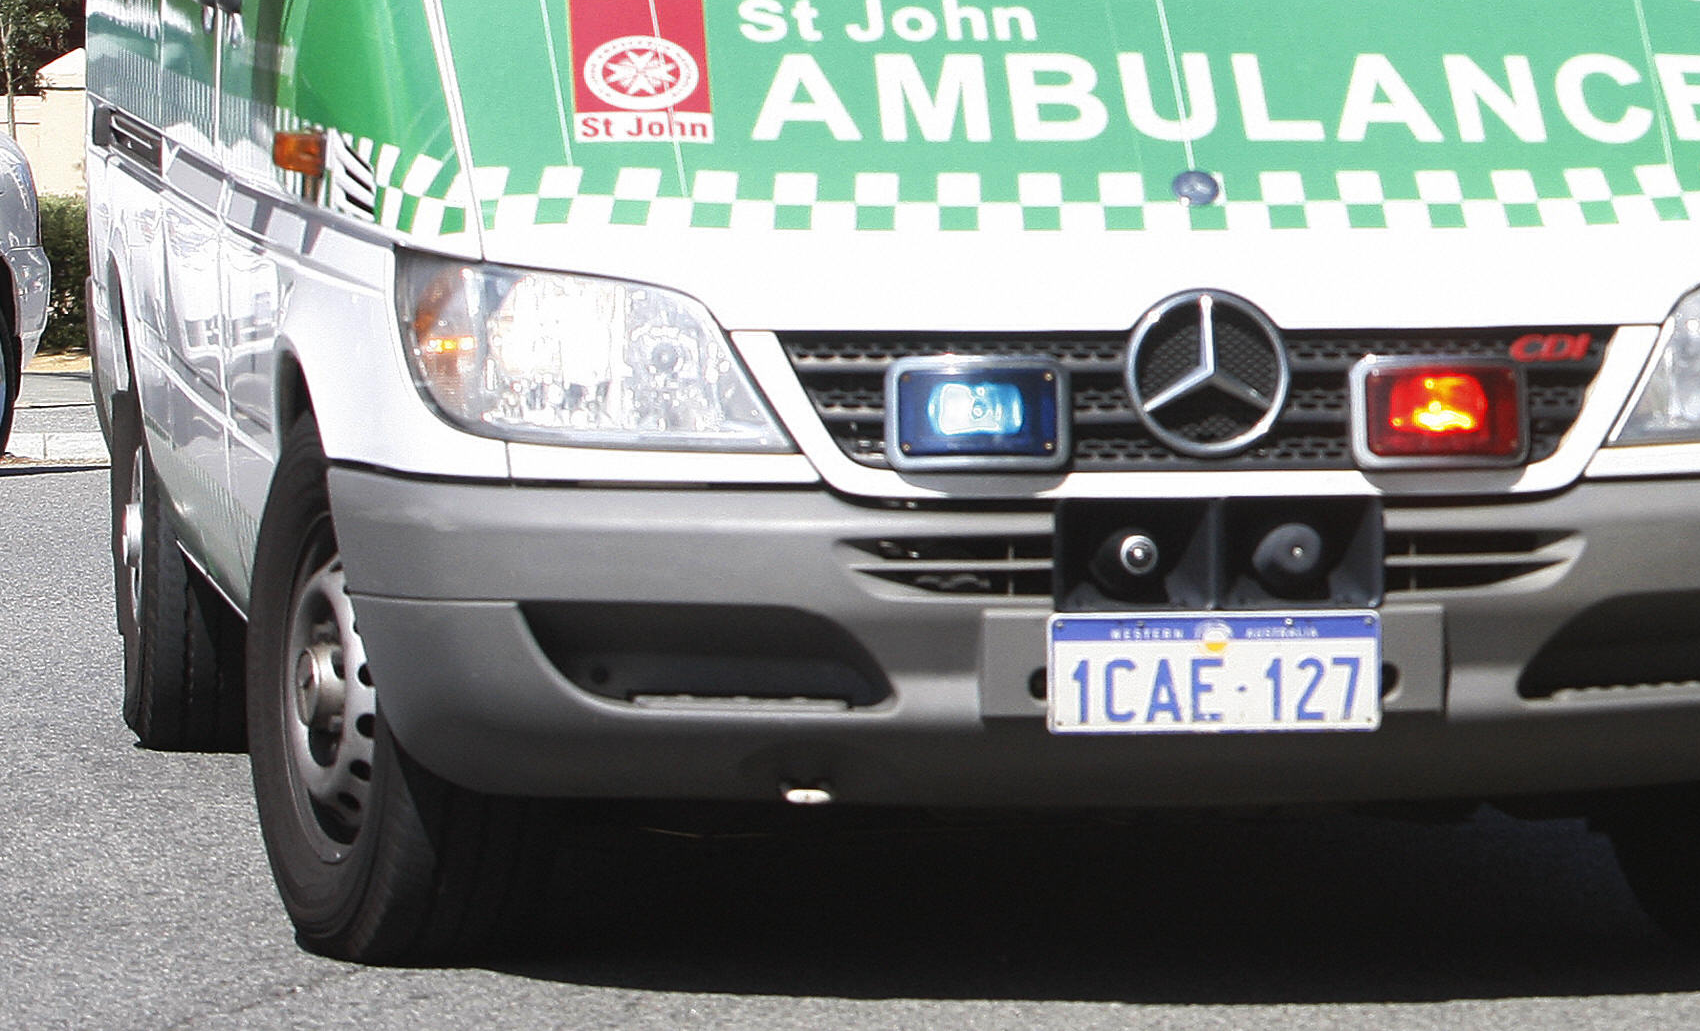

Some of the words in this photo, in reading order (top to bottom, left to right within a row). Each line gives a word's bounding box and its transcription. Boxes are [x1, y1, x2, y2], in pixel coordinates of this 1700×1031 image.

[581, 117, 614, 138] St
[626, 116, 708, 138] John
[1509, 332, 1592, 362] CDI
